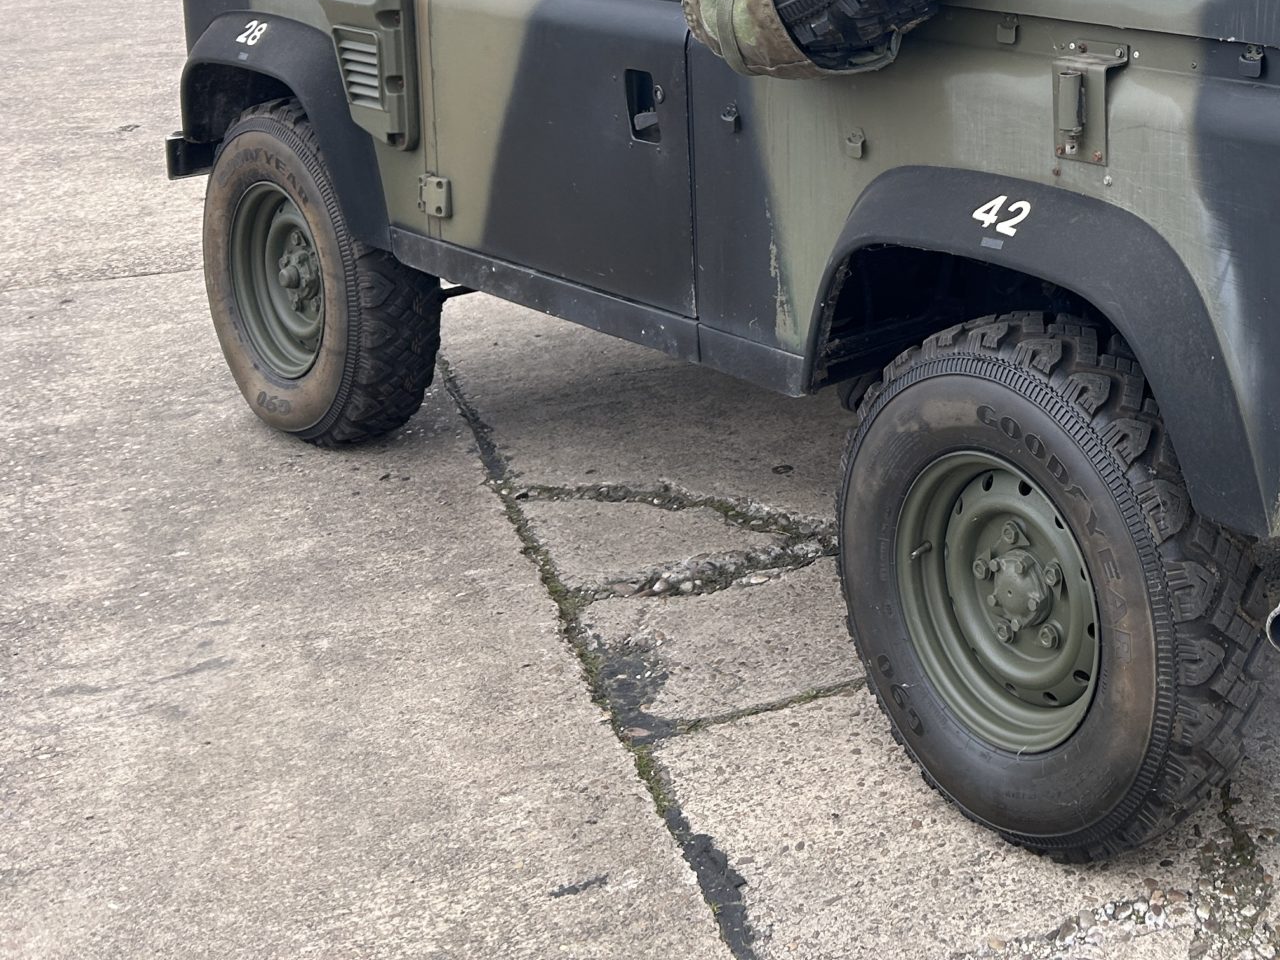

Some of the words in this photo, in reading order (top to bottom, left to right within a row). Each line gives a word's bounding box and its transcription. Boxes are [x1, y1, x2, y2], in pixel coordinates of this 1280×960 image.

[236, 20, 268, 46] 28
[972, 195, 1031, 237] 42
[976, 404, 1132, 664] GOODYEAR
[877, 655, 924, 736] G90
